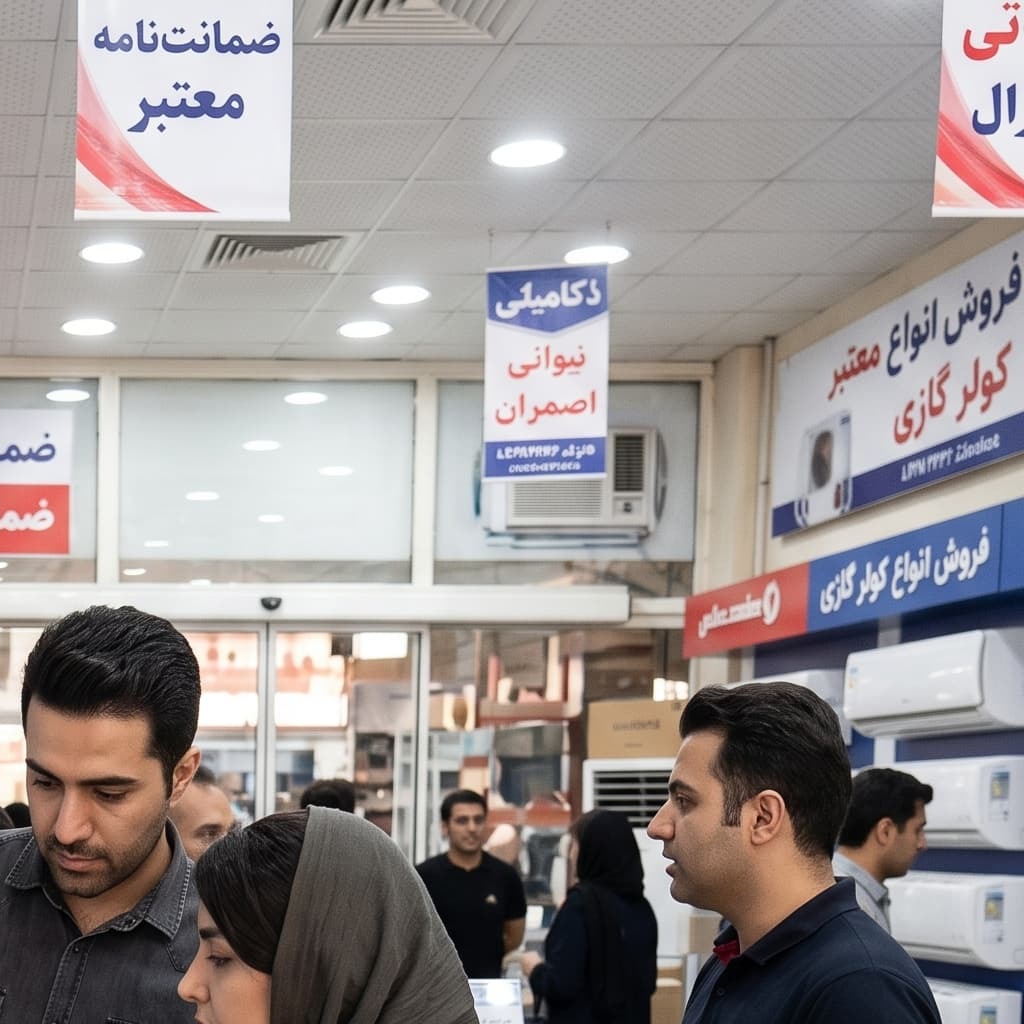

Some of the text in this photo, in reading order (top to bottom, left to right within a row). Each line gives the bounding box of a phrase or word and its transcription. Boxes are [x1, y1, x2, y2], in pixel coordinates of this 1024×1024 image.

[964, 2, 1024, 61] تی
[127, 82, 245, 133] معتبر
[828, 251, 1022, 401] فروش انواع معتبر
[495, 390, 596, 425] اصمران
[893, 341, 1013, 444] کولر گازی
[820, 525, 991, 615] فروش انواع کولر گازی
